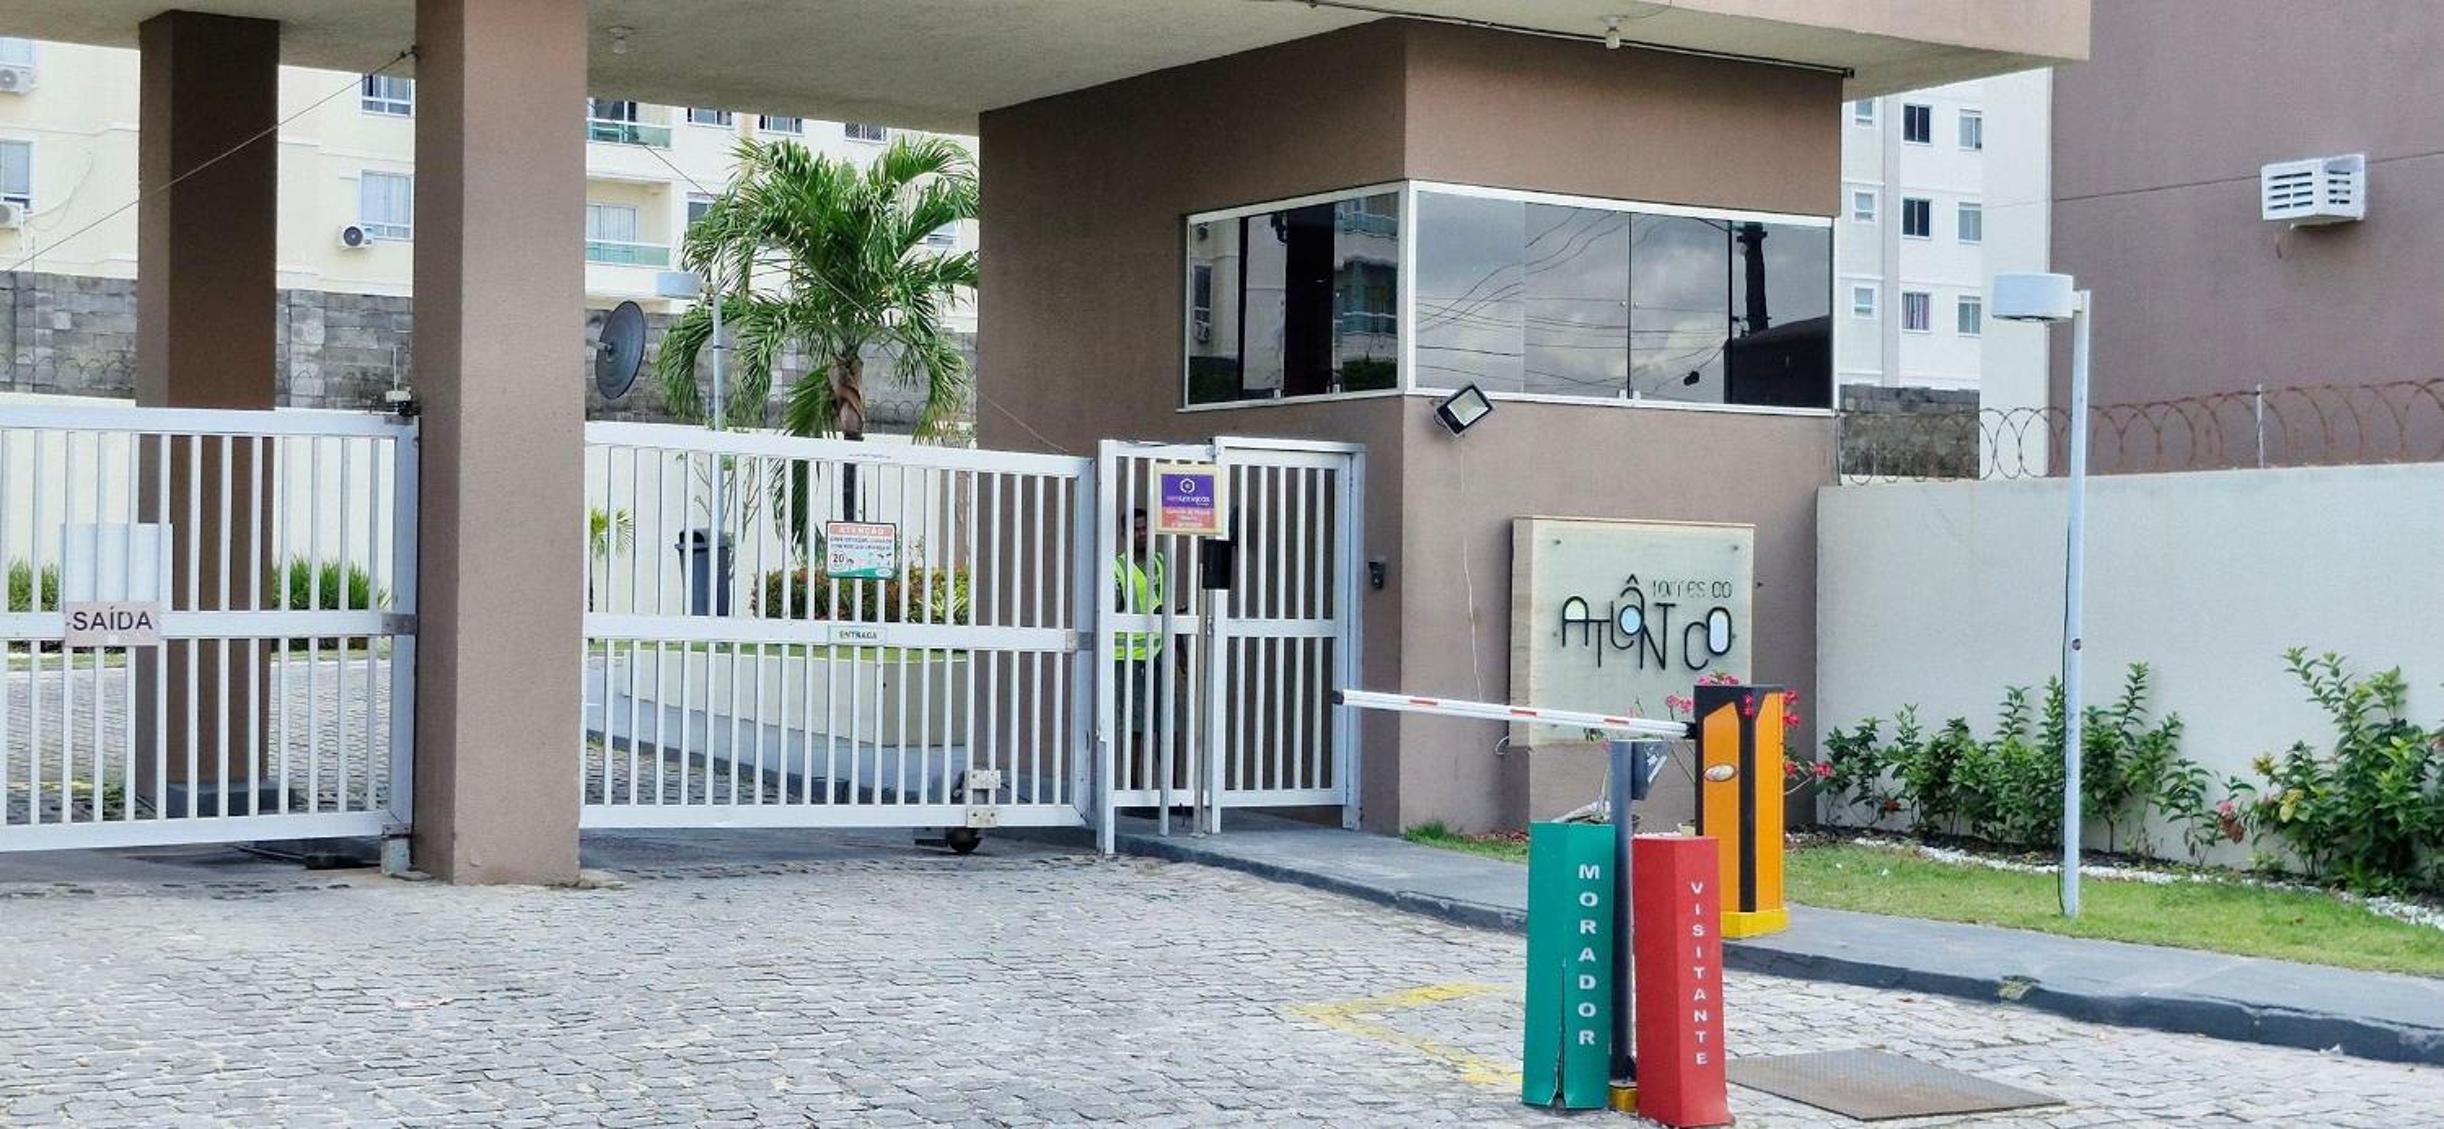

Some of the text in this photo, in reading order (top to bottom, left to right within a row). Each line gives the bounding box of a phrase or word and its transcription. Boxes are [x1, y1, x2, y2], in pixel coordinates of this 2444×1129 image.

[833, 553, 845, 563] 20
[73, 605, 153, 631] SAÍDA
[1578, 863, 1600, 1046] MORADOR
[1690, 881, 1708, 1065] VISITANTE
